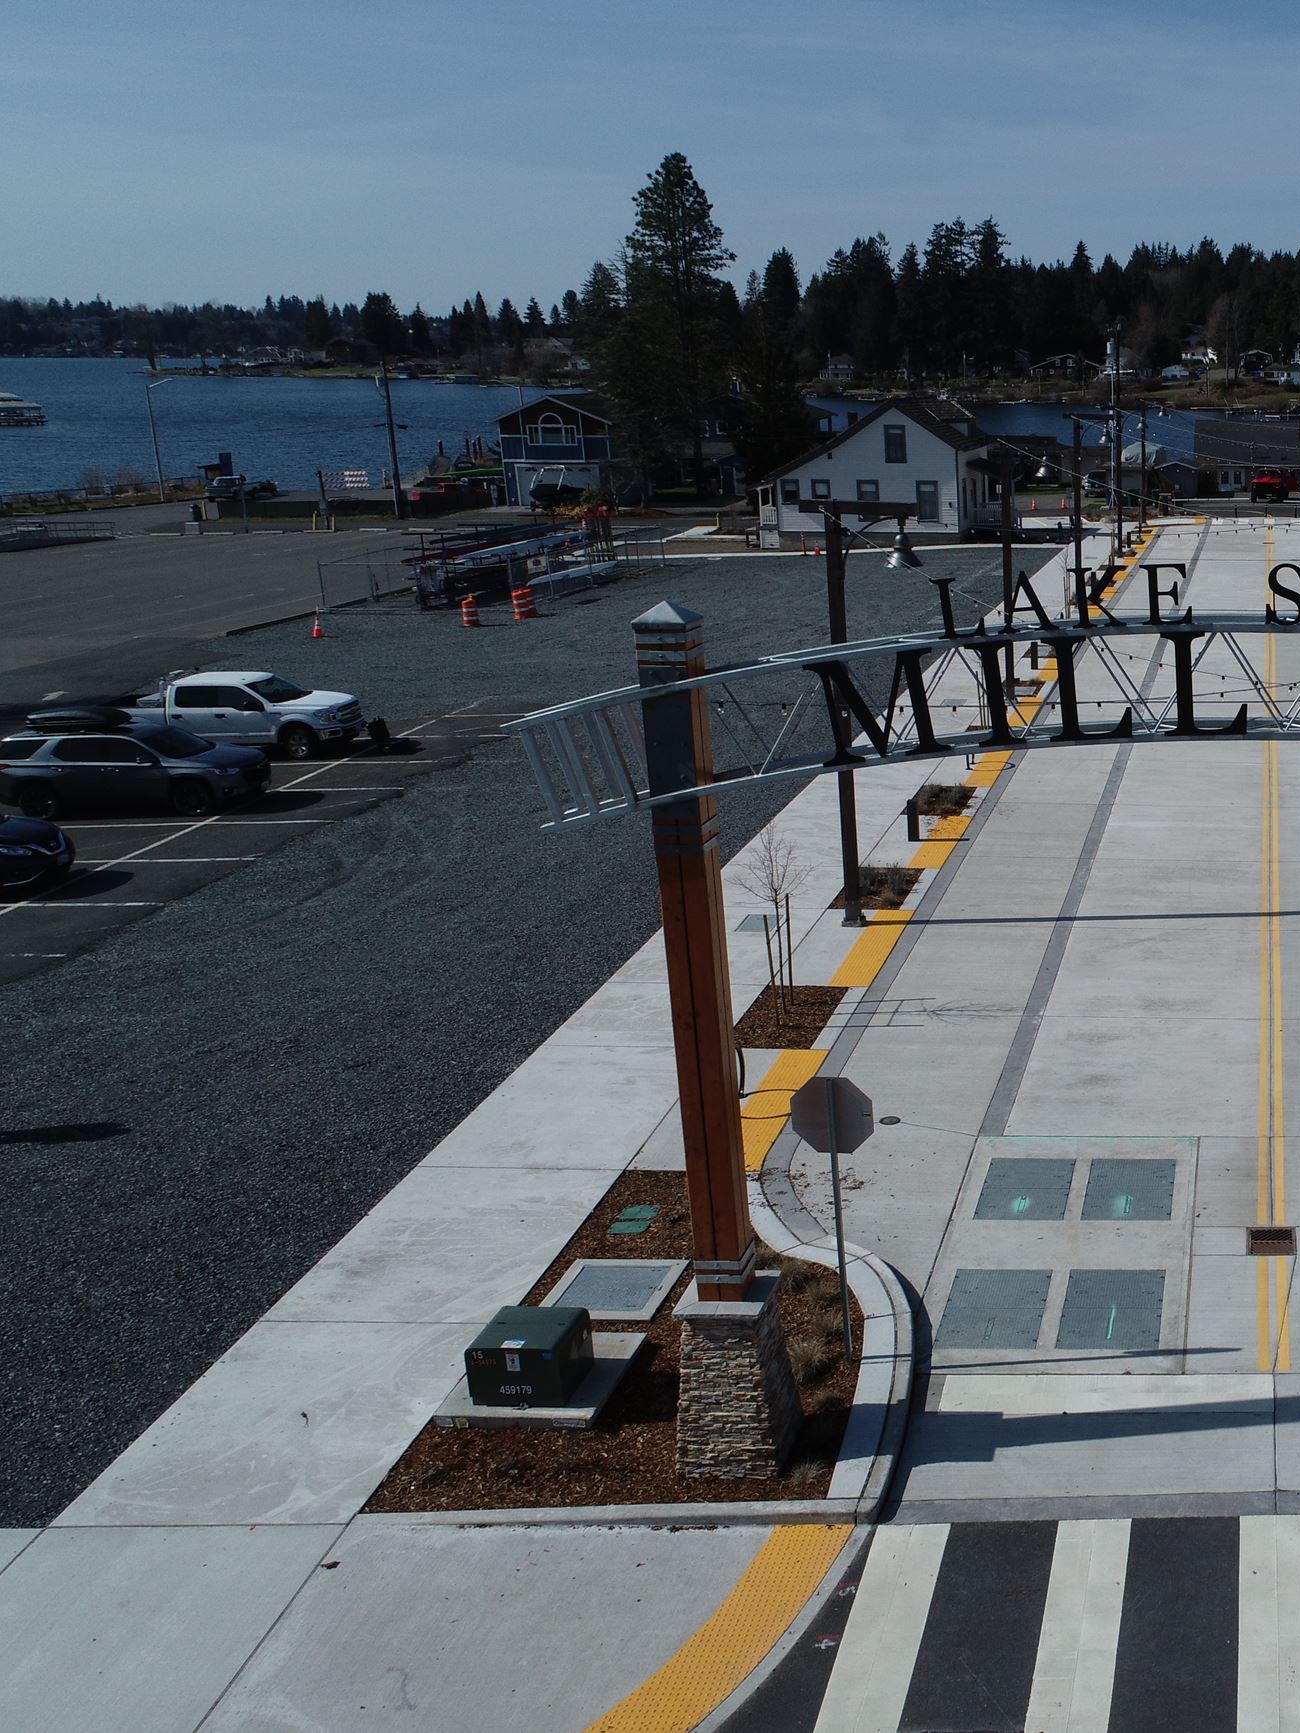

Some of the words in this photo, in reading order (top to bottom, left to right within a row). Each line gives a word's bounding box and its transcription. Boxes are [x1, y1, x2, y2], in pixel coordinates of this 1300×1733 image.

[928, 563, 1193, 639] LAKE
[803, 631, 1248, 767] MILL
[472, 1351, 484, 1360] 15
[499, 1385, 533, 1395] 459179
